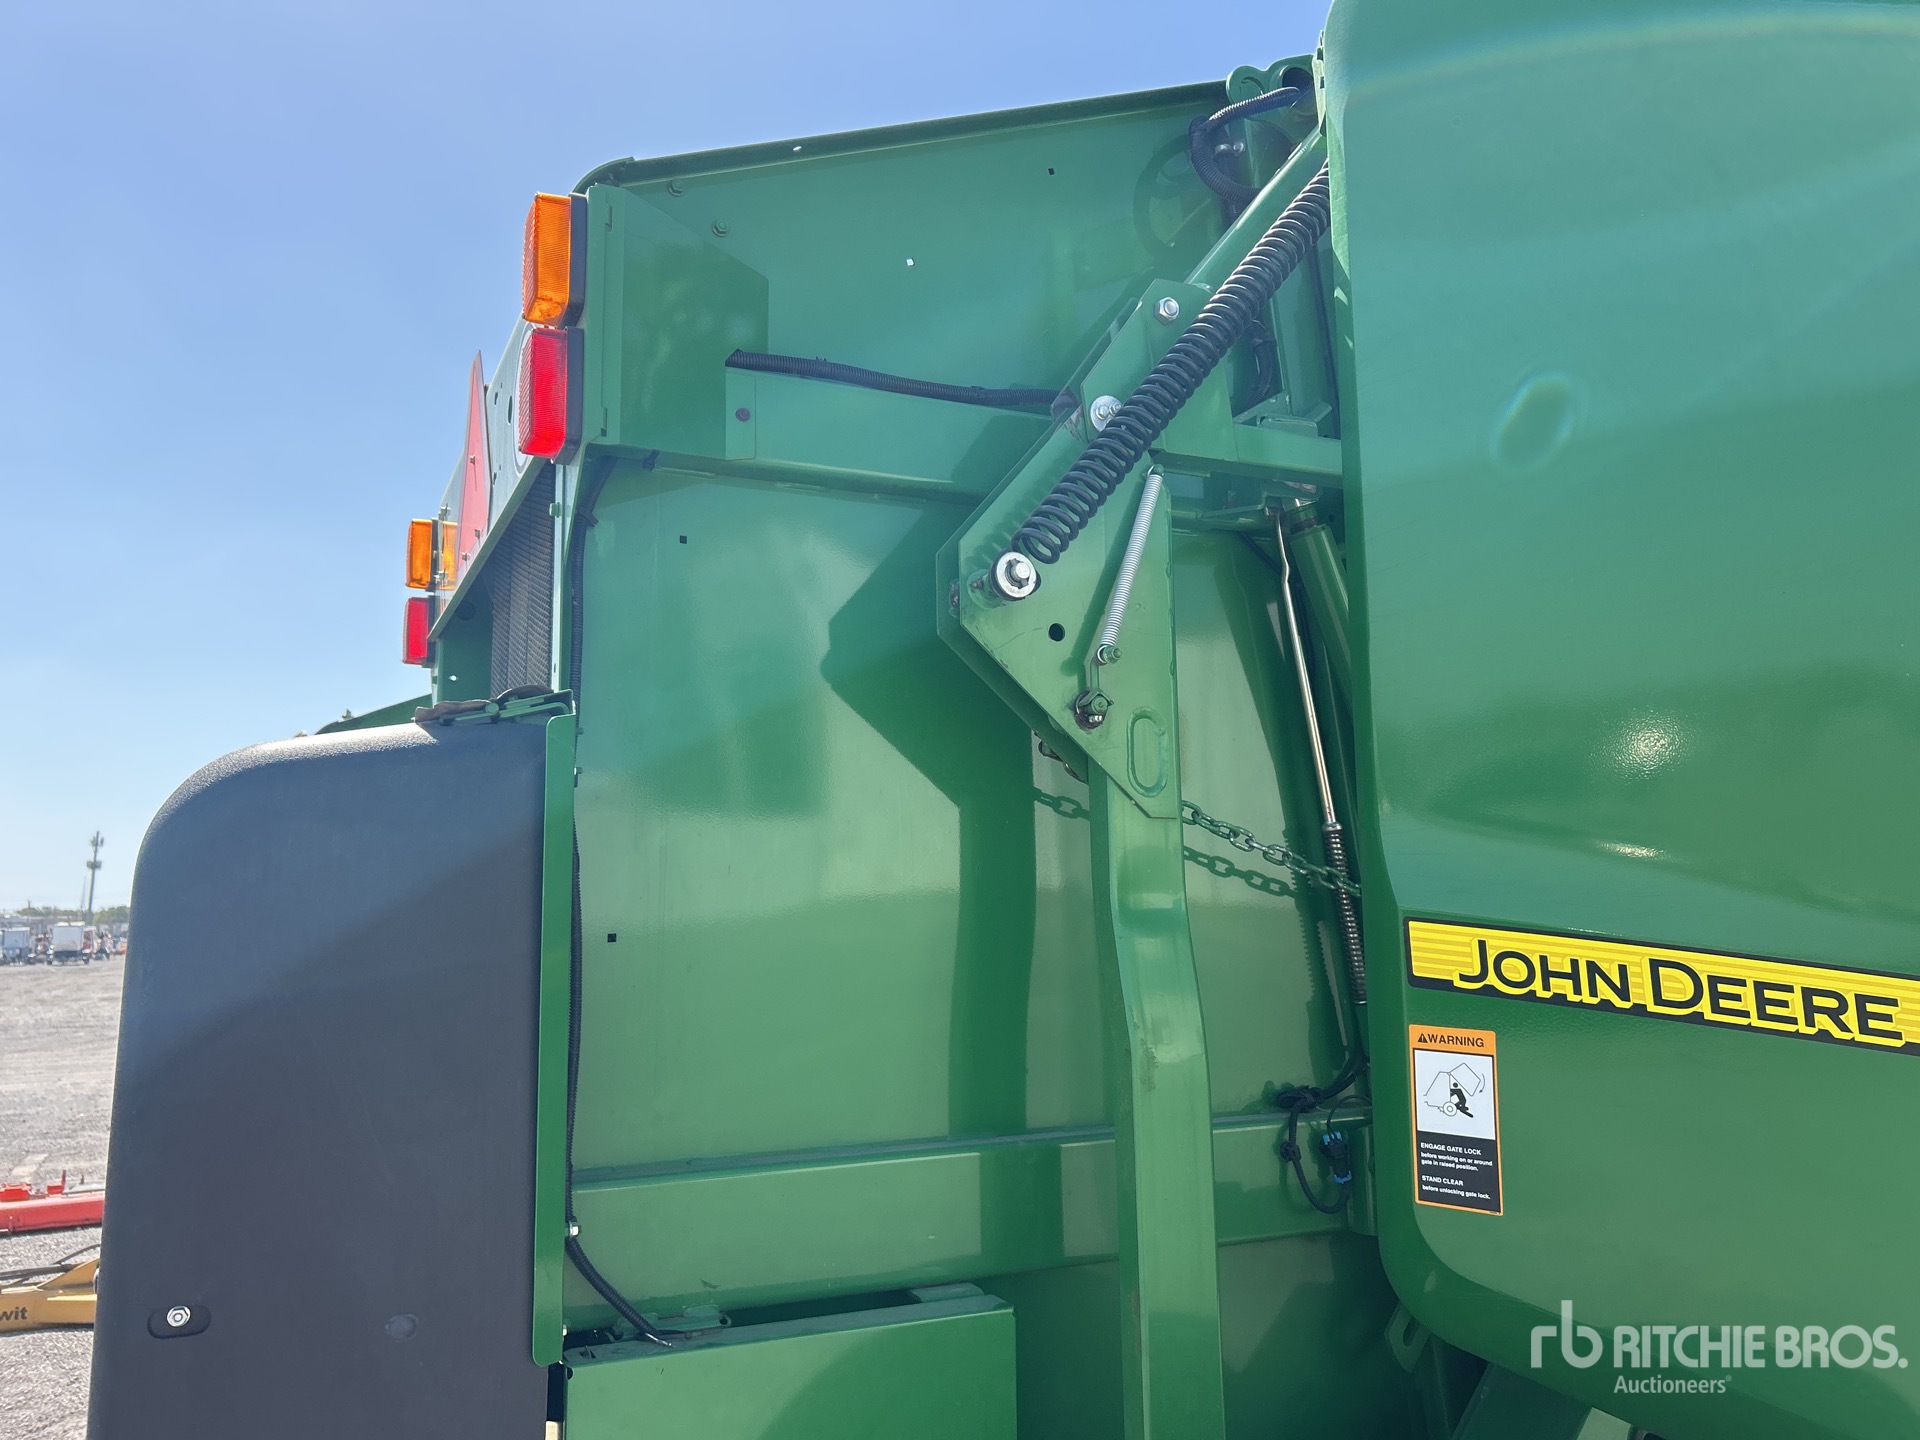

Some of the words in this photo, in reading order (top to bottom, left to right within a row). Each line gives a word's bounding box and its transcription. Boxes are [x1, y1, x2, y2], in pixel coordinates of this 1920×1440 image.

[1457, 937, 1632, 1004] JOHN
[1647, 958, 1904, 1042] DEERE
[1427, 1033, 1485, 1048] WARNING
[1420, 1142, 1446, 1151] ENGAGE
[1446, 1145, 1463, 1153] GATE
[1420, 1151, 1437, 1159] before
[1438, 1154, 1458, 1163] working
[1473, 1159, 1493, 1167] around
[1439, 1160, 1455, 1168] raised
[1421, 1175, 1442, 1183] STAND
[1442, 1177, 1464, 1186] CLEAR
[1422, 1184, 1439, 1192] before
[1439, 1187, 1465, 1197] unlocking
[1477, 1192, 1491, 1200] lock.
